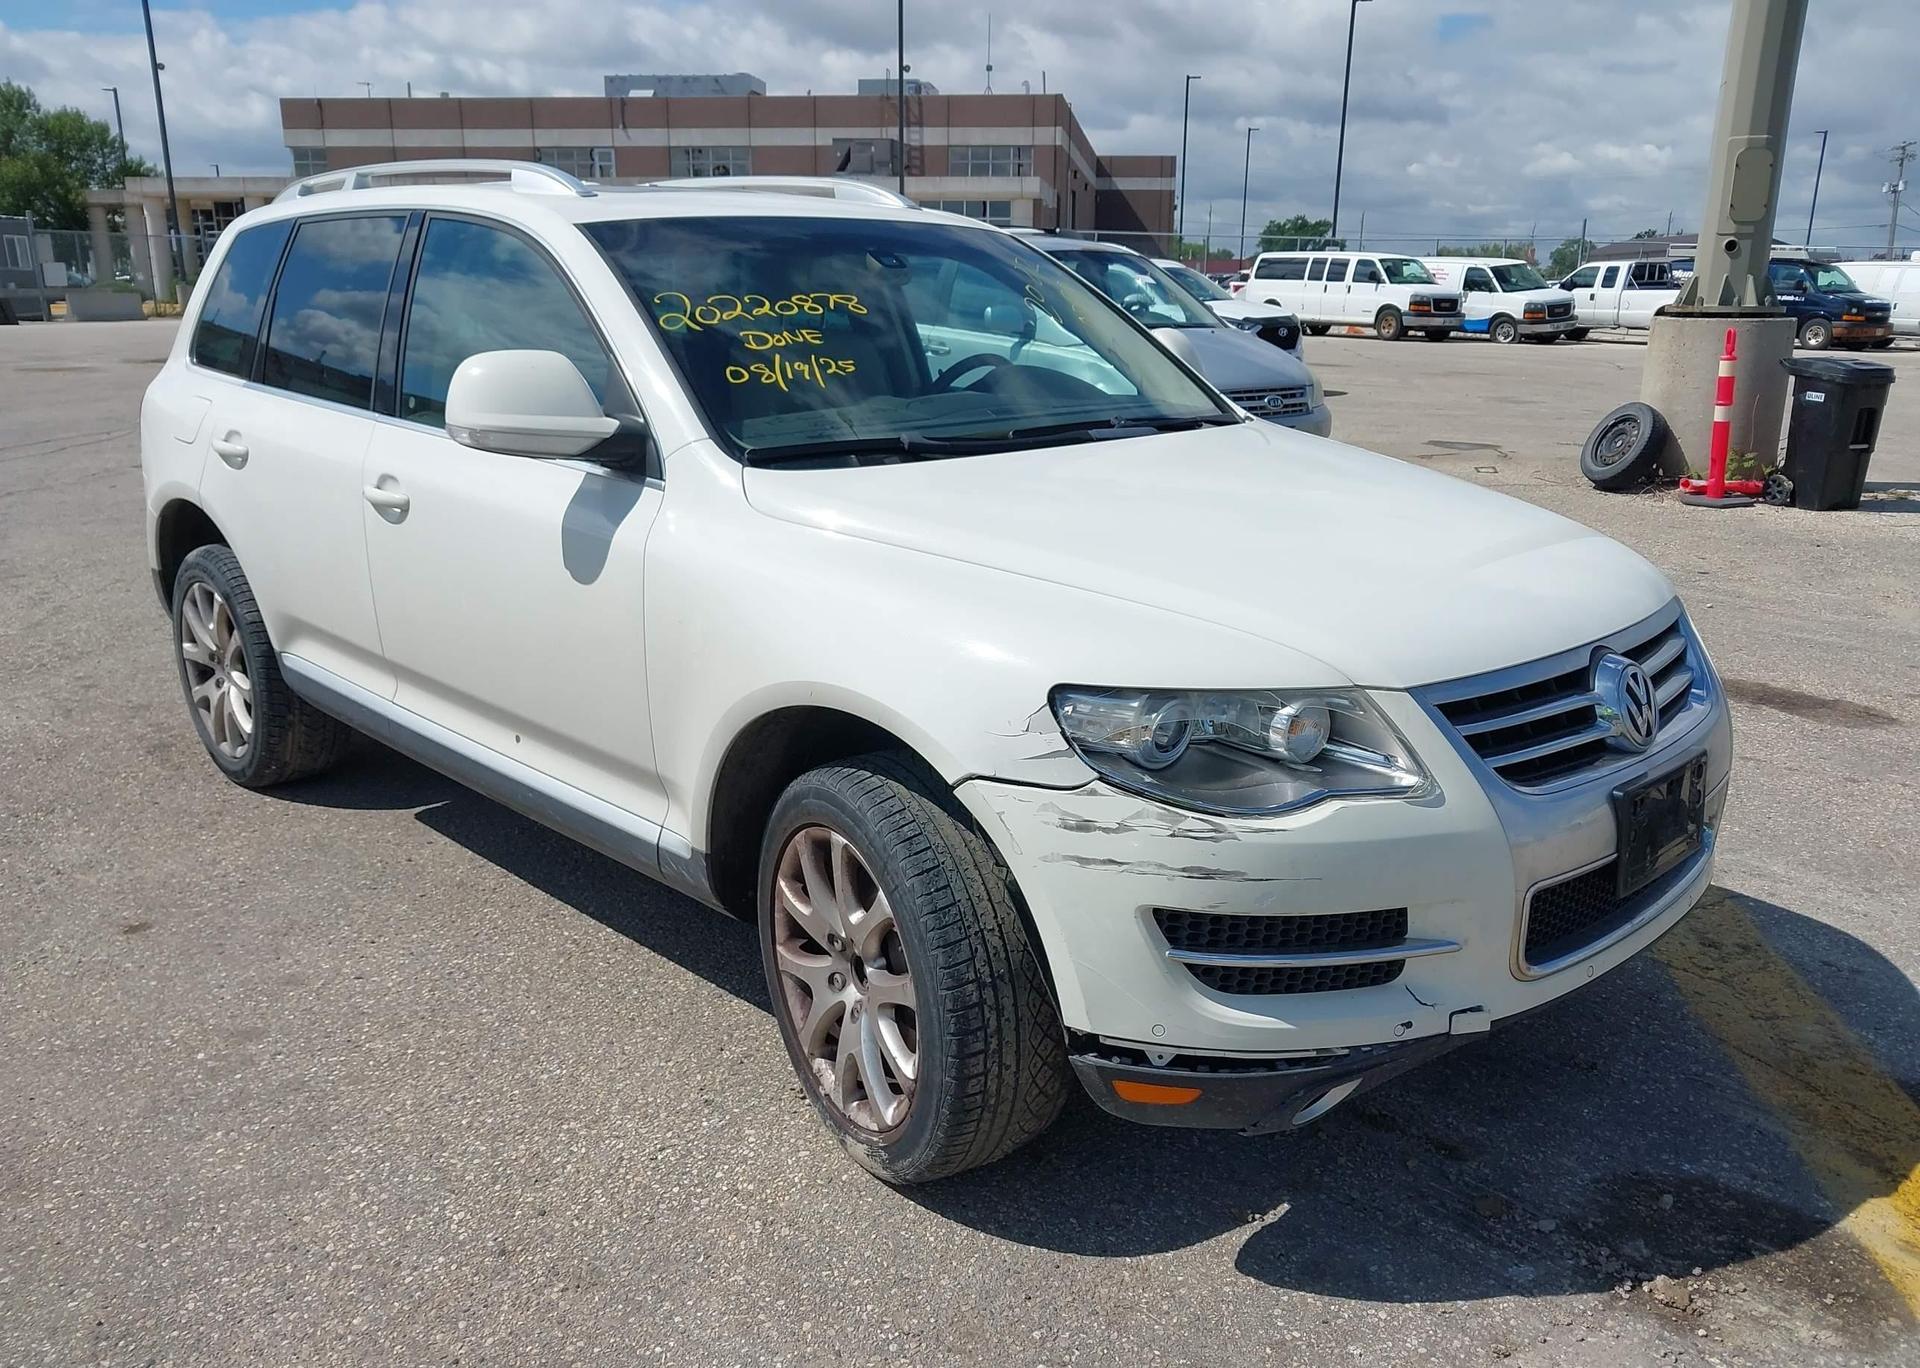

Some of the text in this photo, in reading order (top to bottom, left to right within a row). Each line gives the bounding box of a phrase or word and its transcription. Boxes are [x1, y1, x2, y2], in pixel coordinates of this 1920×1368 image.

[654, 292, 868, 331] 20220878
[739, 329, 824, 350] DONE
[725, 353, 856, 392] 08/19/25
[1267, 396, 1284, 408] KIA
